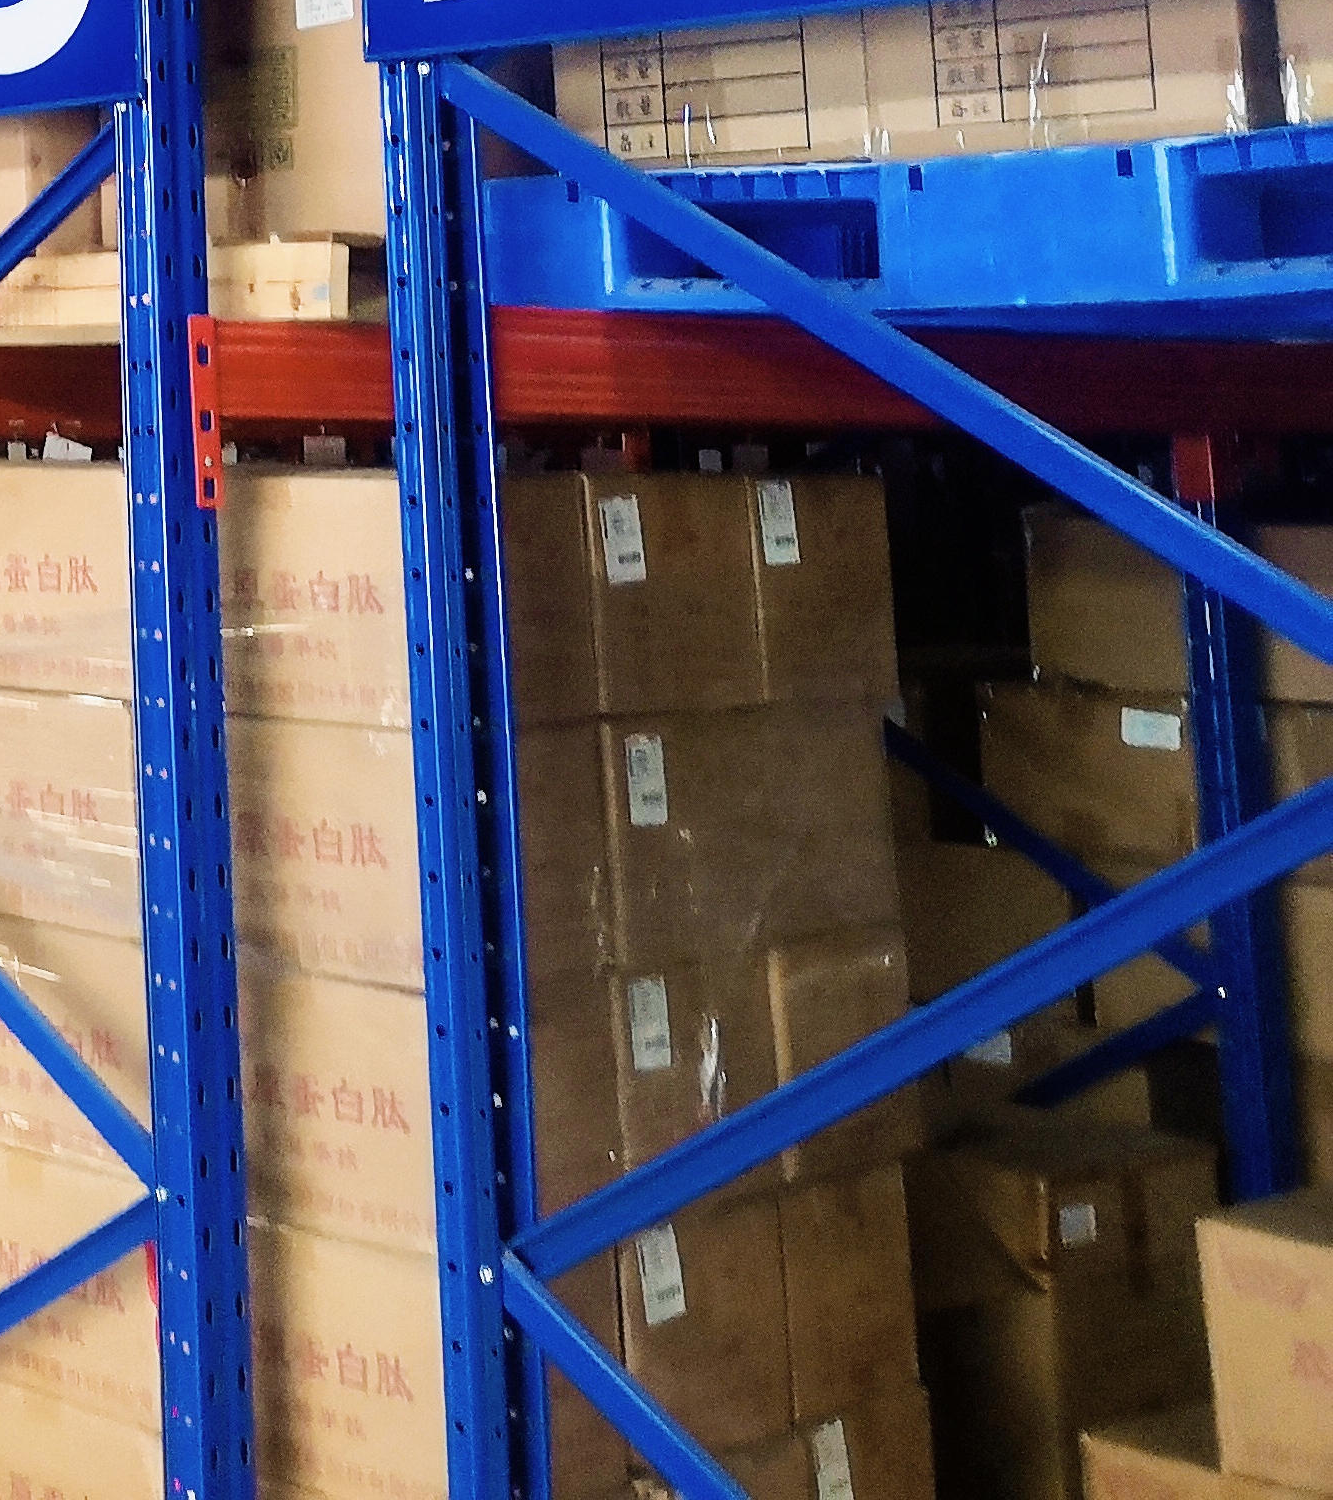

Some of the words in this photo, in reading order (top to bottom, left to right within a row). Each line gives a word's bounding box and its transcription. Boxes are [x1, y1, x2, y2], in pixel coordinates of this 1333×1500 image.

[232, 568, 386, 615] 原蛋白肽
[234, 808, 388, 870] 原蛋白肽
